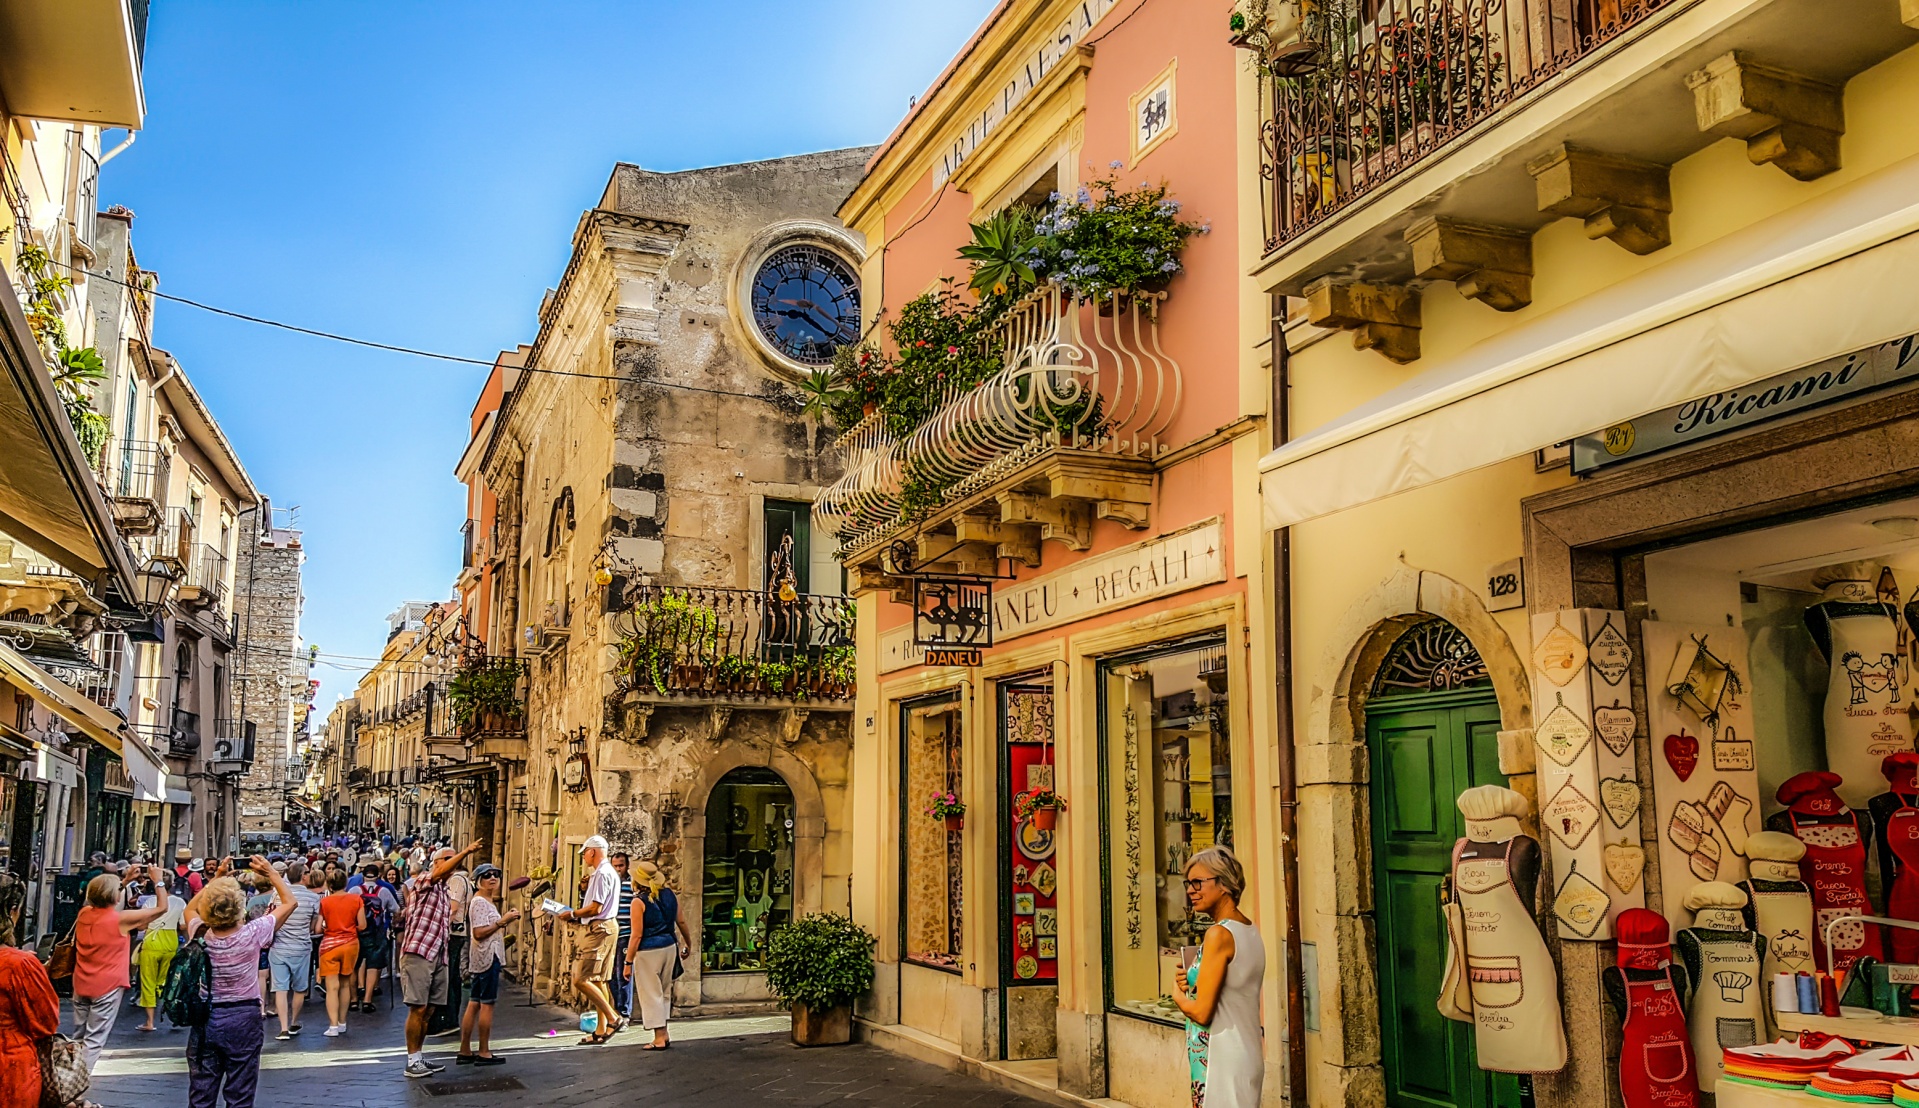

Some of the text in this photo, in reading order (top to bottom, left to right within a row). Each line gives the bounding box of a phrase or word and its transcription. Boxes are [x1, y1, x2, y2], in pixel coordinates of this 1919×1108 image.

[940, 101, 996, 186] ARTE
[1674, 354, 1864, 434] Ricami
[1096, 549, 1189, 605] REGALI
[1488, 573, 1518, 598] 128
[926, 651, 980, 666] DANEU
[1844, 704, 1876, 717] Luca
[1597, 712, 1634, 724] Mamma
[1470, 825, 1492, 839] Chef
[347, 853, 352, 861] 5
[1814, 860, 1848, 871] Irene
[1461, 867, 1486, 879] Rosa
[1815, 880, 1846, 889] Cuoca
[1714, 911, 1737, 924] Chef
[1774, 943, 1810, 957] Martina
[1705, 951, 1755, 964] Tommaso
[1632, 997, 1669, 1016] Viola
